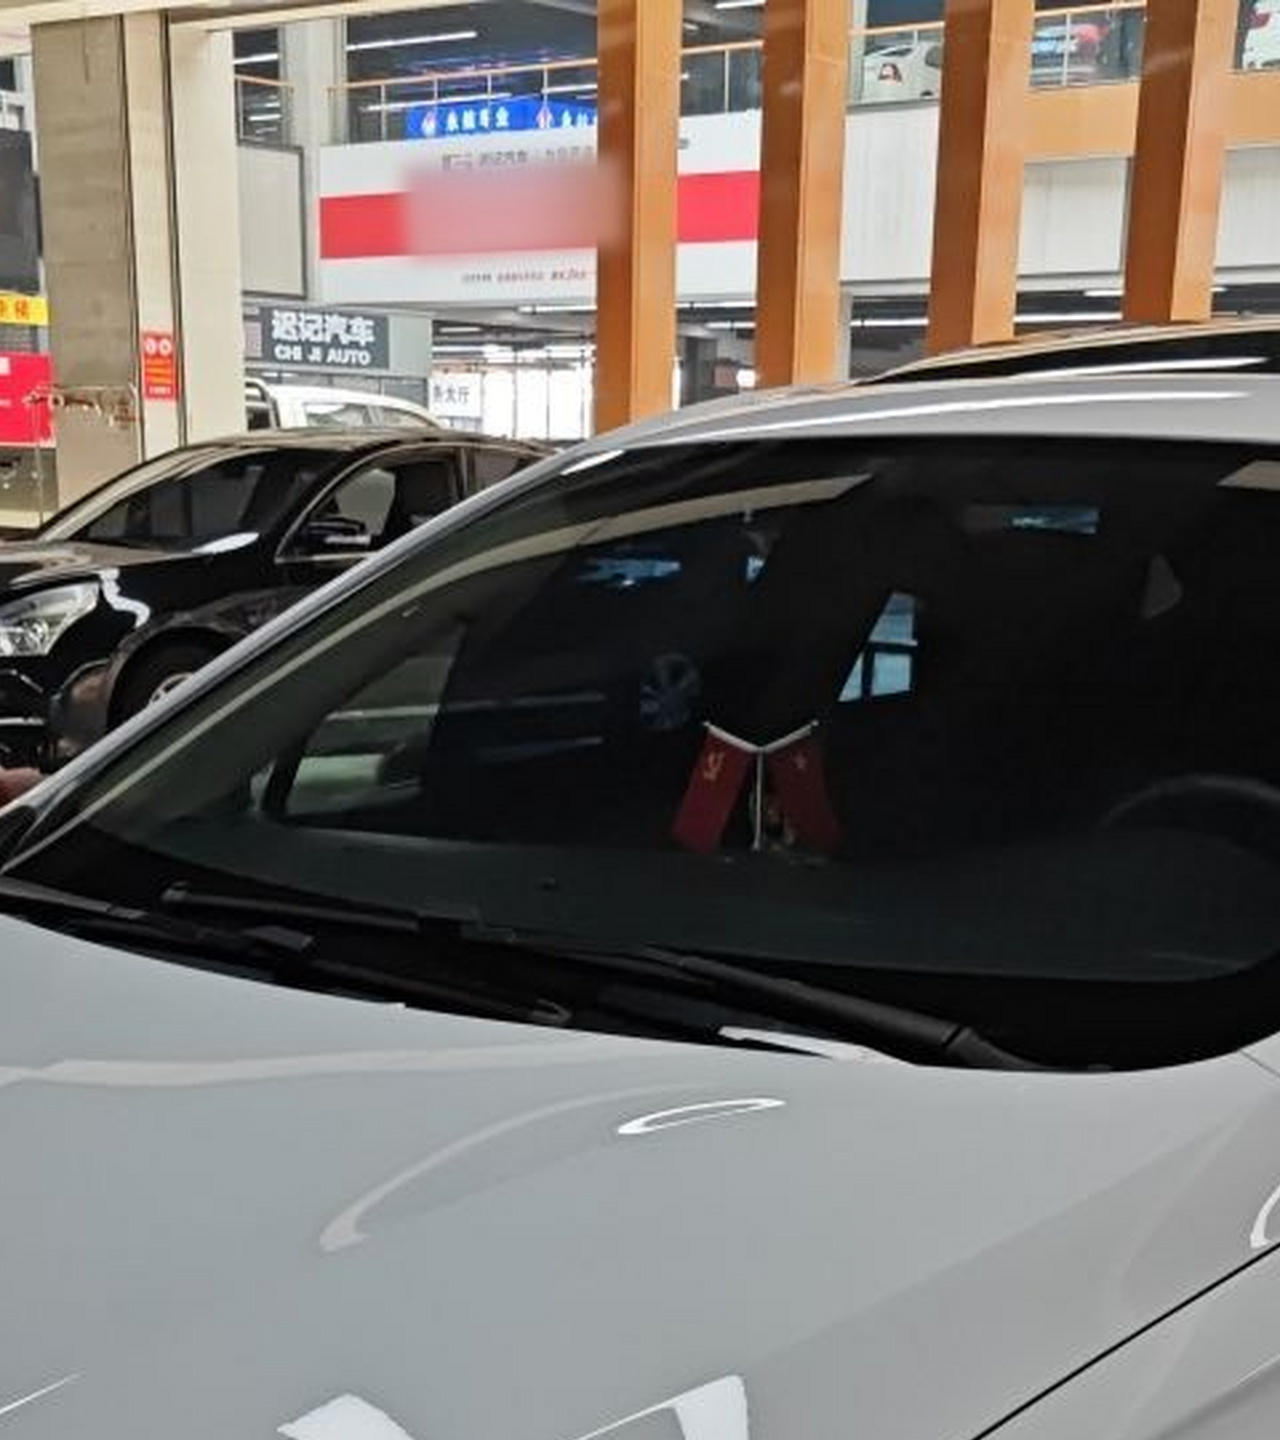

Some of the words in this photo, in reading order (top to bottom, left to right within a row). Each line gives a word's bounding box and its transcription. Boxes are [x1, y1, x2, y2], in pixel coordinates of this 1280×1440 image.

[272, 310, 375, 346] 迟记汽车
[275, 345, 302, 361] CHI
[308, 347, 322, 362] JI
[326, 348, 370, 365] AUTO
